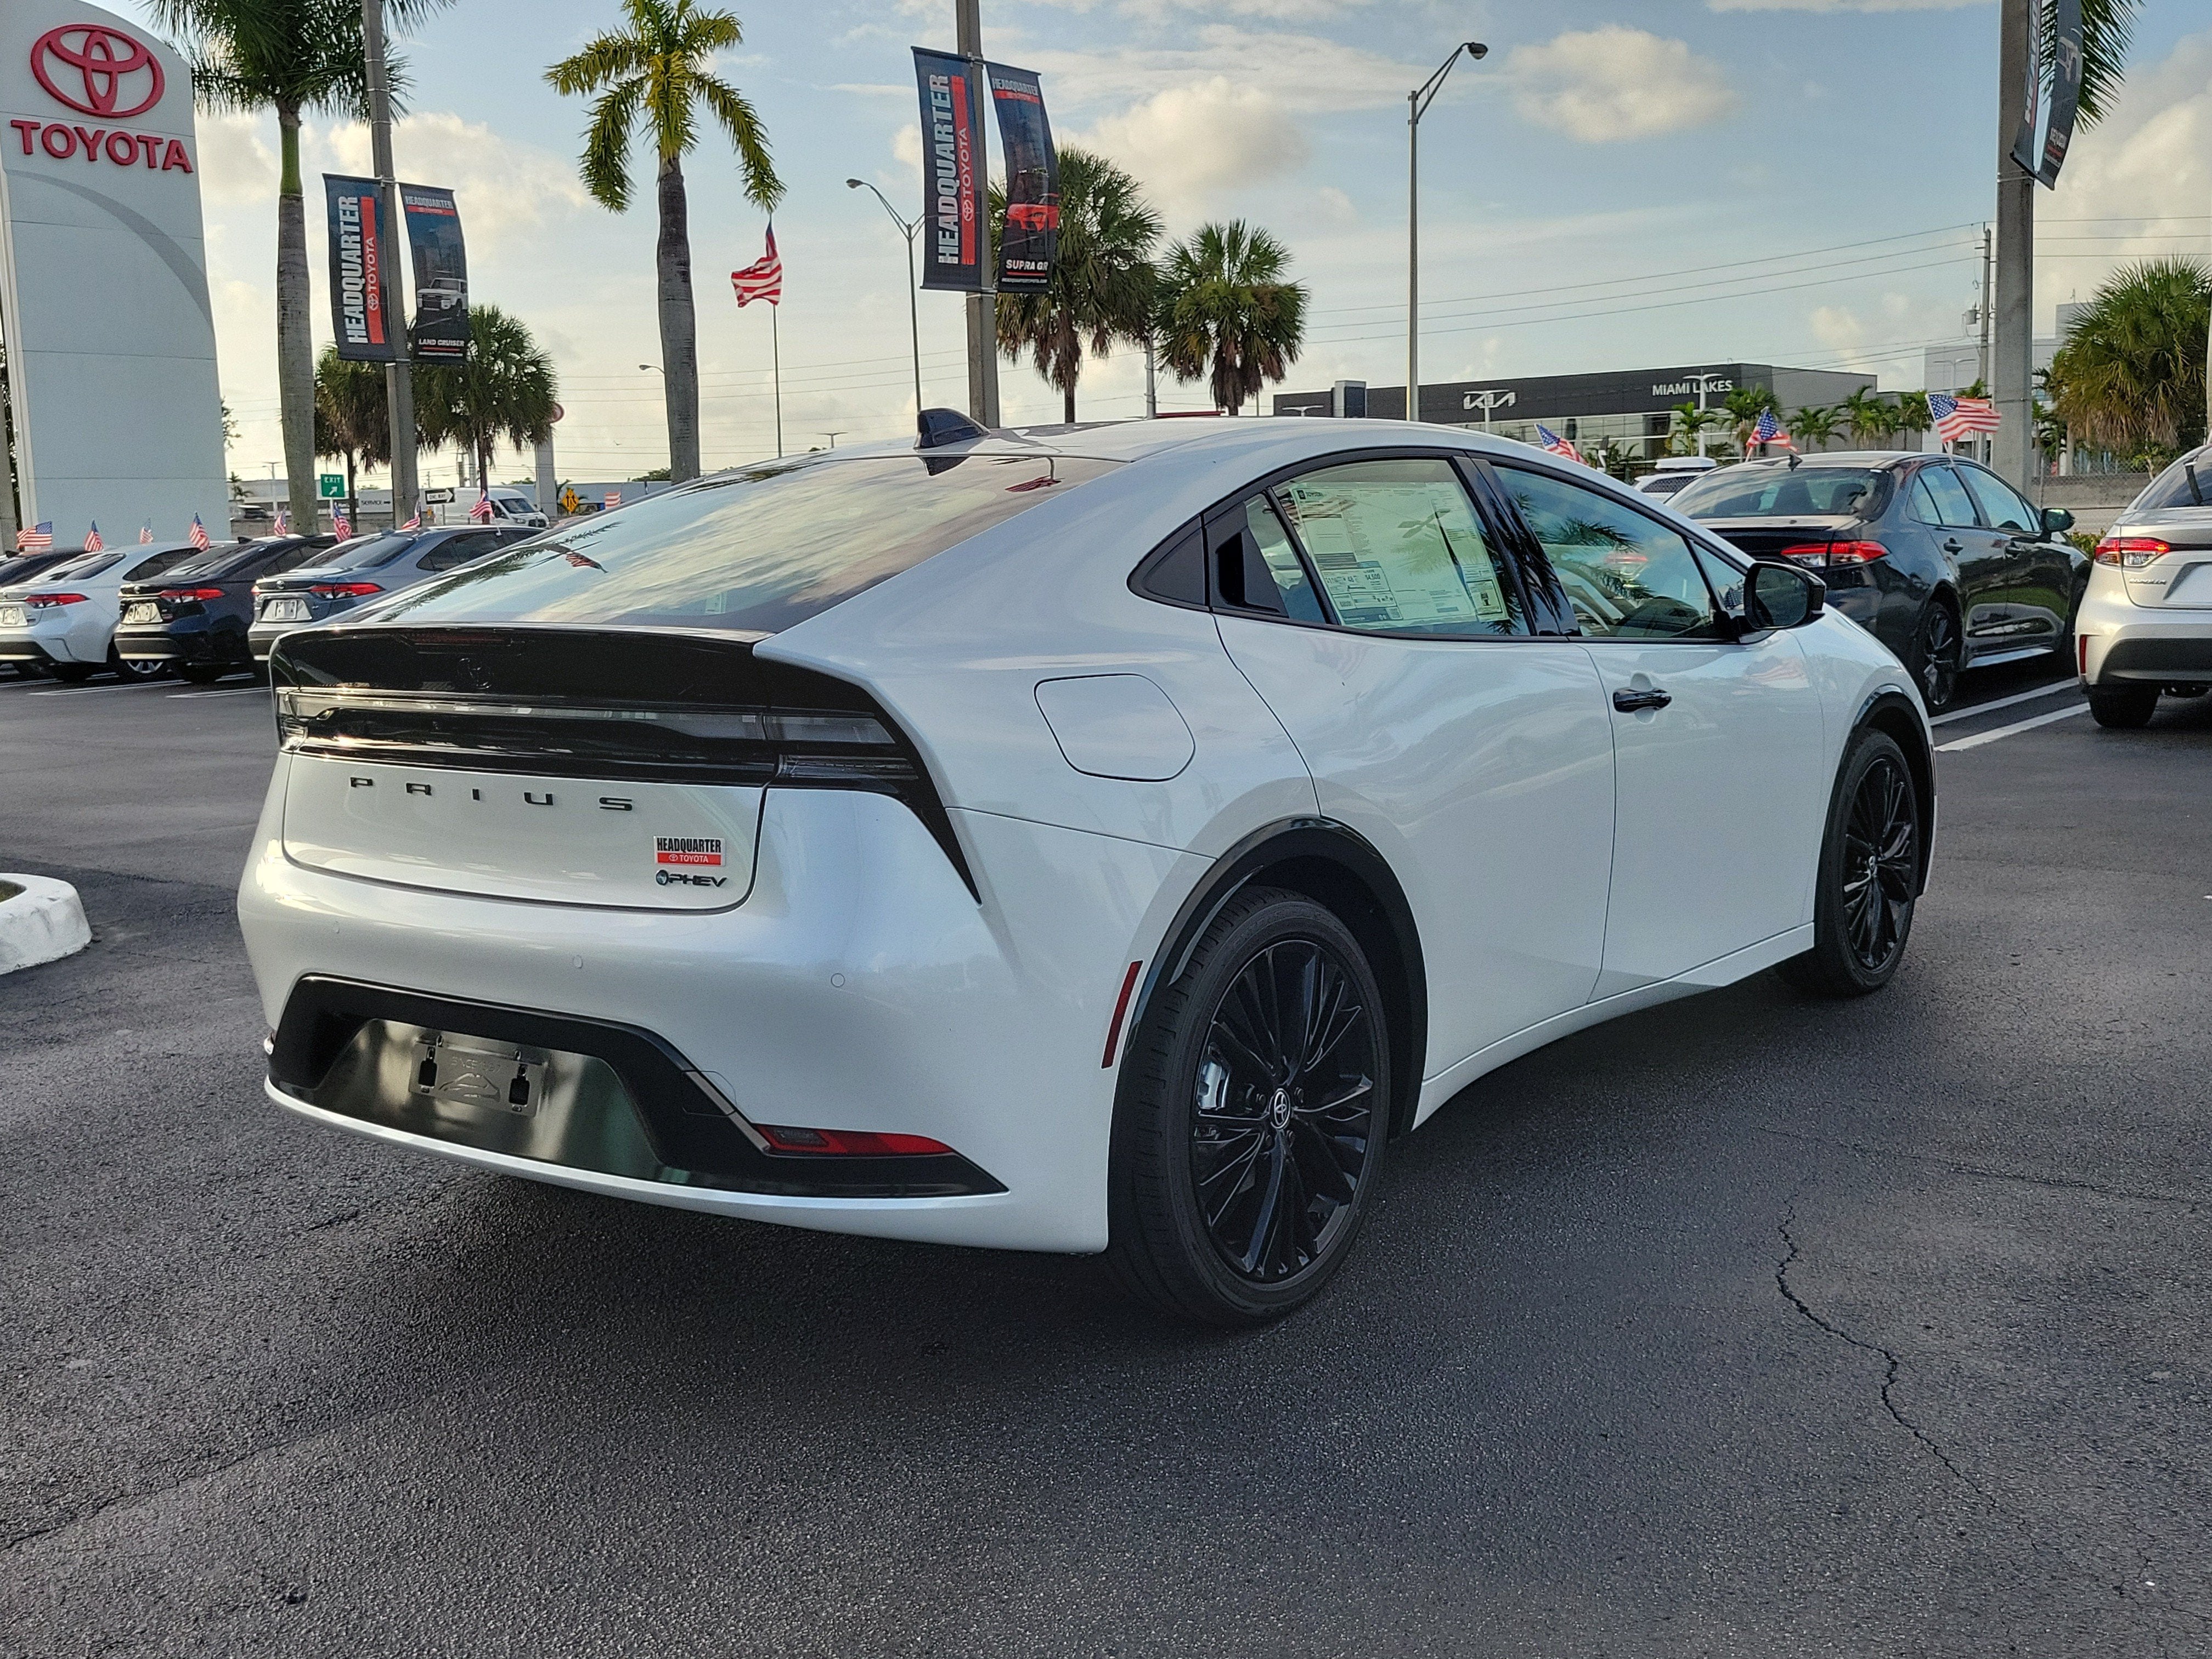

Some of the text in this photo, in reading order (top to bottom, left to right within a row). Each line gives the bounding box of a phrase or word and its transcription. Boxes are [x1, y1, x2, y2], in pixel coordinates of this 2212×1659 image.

[991, 78, 1039, 96] HEADQUARTER
[10, 119, 194, 173] TOYOTA
[929, 74, 960, 264] HEADQUARTER
[959, 127, 972, 198] TOYOTA
[405, 195, 454, 210] HEADQUARTER
[338, 195, 369, 344] HEADQUARTER
[365, 237, 377, 292] TOYOTA
[1005, 258, 1049, 271] SUPRA GR
[437, 339, 465, 347] CRUISER
[1652, 382, 1690, 396] MIAMI
[1463, 392, 1516, 410] KIA
[350, 777, 633, 811] PRIUS
[657, 837, 721, 853] HEADQUARTER
[679, 854, 709, 863] TOYOTA
[668, 873, 727, 887] PHEV
